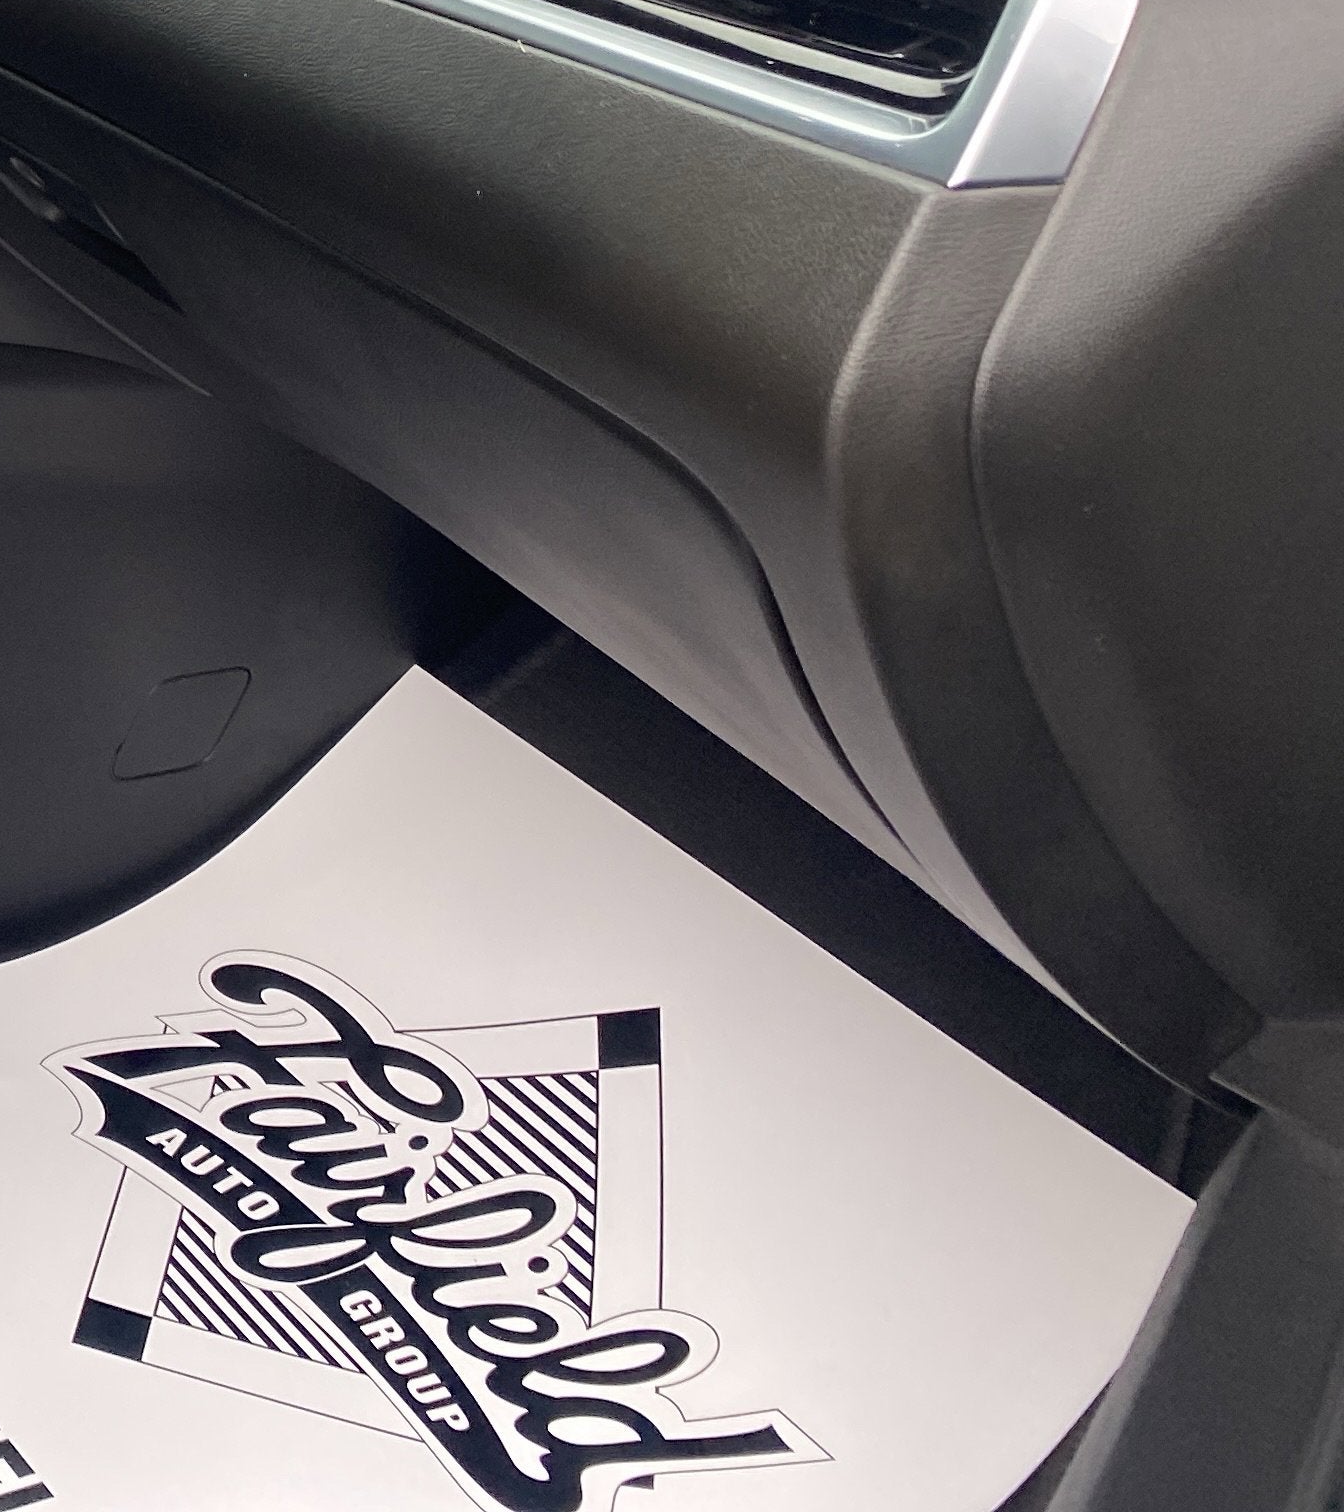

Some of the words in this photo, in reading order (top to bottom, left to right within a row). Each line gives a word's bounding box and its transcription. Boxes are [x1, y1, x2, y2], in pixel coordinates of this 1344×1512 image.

[82, 963, 795, 1500] Fairfield
[145, 1127, 280, 1221] AUTO
[339, 1289, 470, 1432] GROUP
